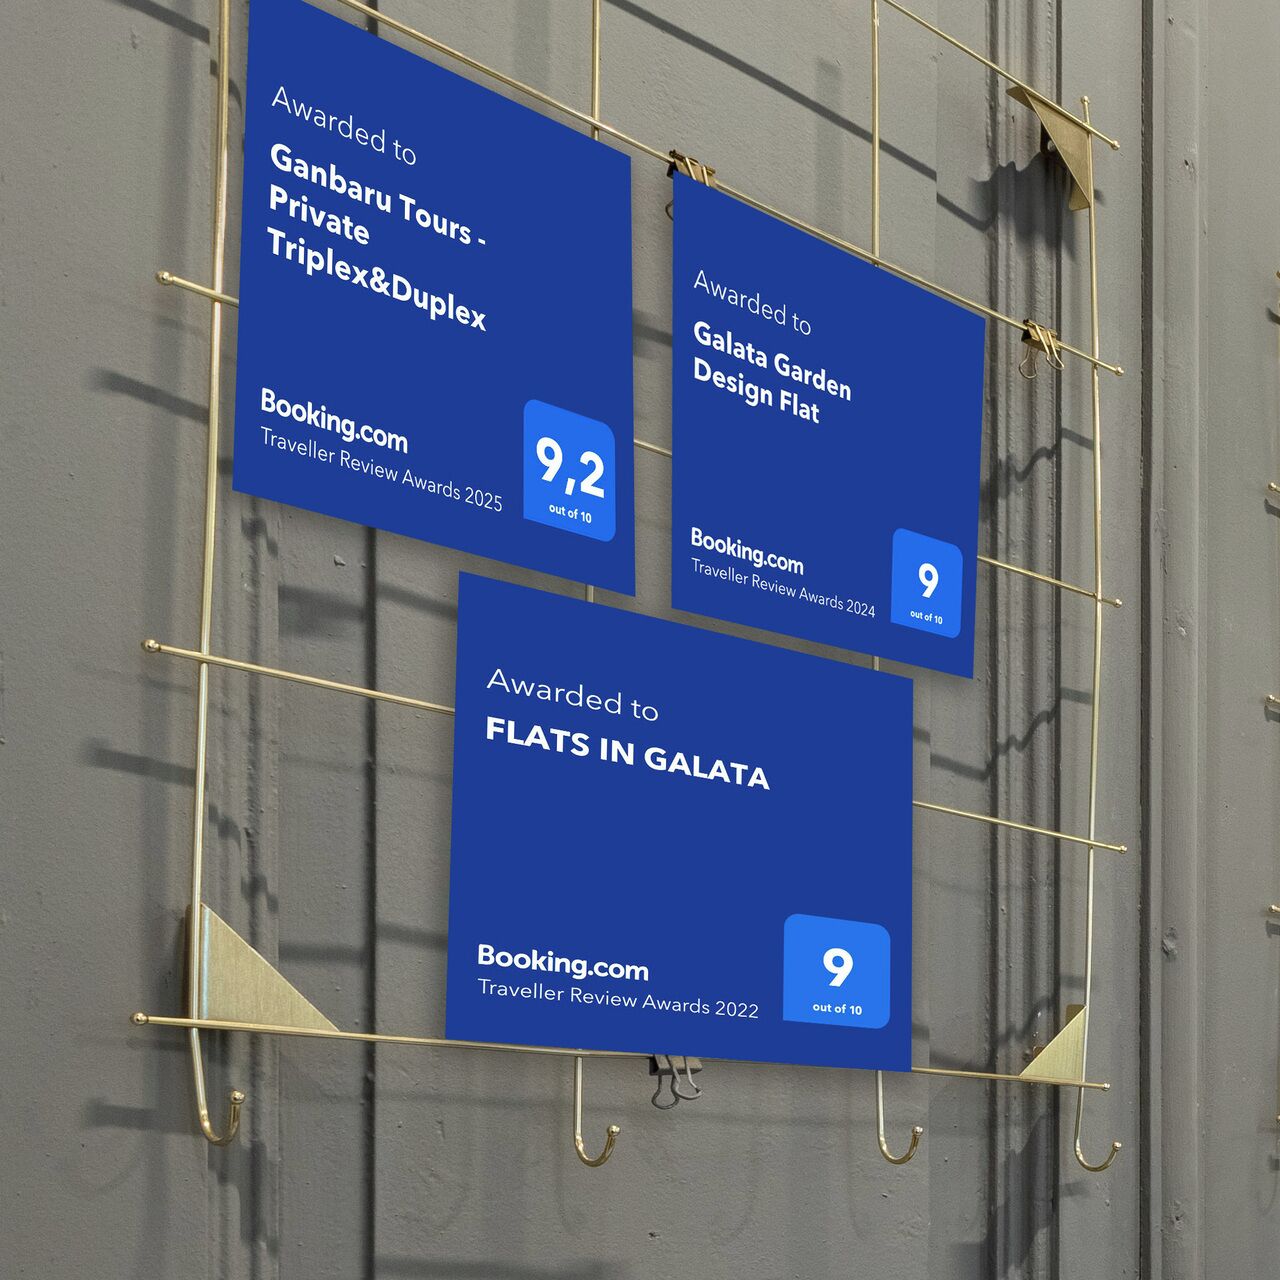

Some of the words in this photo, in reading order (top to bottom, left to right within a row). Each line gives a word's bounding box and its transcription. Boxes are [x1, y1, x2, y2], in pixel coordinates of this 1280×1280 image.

[271, 85, 386, 154] Awarded
[392, 139, 417, 166] to
[269, 183, 370, 245] Private
[270, 143, 392, 214] Ganbaru
[398, 193, 472, 245] Tours
[266, 226, 487, 332] Triplex&Duplex
[693, 269, 786, 326] Awarded
[791, 312, 812, 336] to
[693, 320, 768, 369] Galata
[773, 352, 852, 402] Garden
[693, 356, 773, 407] Design
[779, 388, 820, 424] Flat
[261, 387, 408, 455] Booking.com
[260, 425, 336, 464] Traveller
[340, 449, 399, 482] Review
[401, 468, 461, 500] Awards
[464, 486, 503, 512] 2025
[535, 436, 605, 499] 9,2
[548, 504, 566, 517] out
[567, 508, 579, 520] of
[580, 511, 592, 524] 10
[691, 526, 804, 576] Booking.com
[918, 562, 939, 599] 9
[690, 557, 749, 585] Traveller
[751, 573, 797, 598] Review
[798, 586, 844, 611] Awards
[846, 598, 876, 618] 2024
[910, 610, 924, 620] out
[923, 612, 933, 622] of
[933, 615, 943, 625] 10
[486, 668, 622, 715] Awarded
[630, 699, 659, 722] to
[486, 715, 590, 757] FLATS
[600, 737, 635, 766] IN
[643, 746, 771, 791] GALATA
[477, 943, 649, 982] Booking.com
[822, 947, 854, 988] 9
[477, 977, 565, 1001] Traveller
[570, 986, 638, 1008] Review
[641, 994, 710, 1015] Awards
[714, 1000, 759, 1019] 2022
[812, 1003, 833, 1013] out
[834, 1003, 847, 1014] of
[849, 1005, 863, 1016] 10
